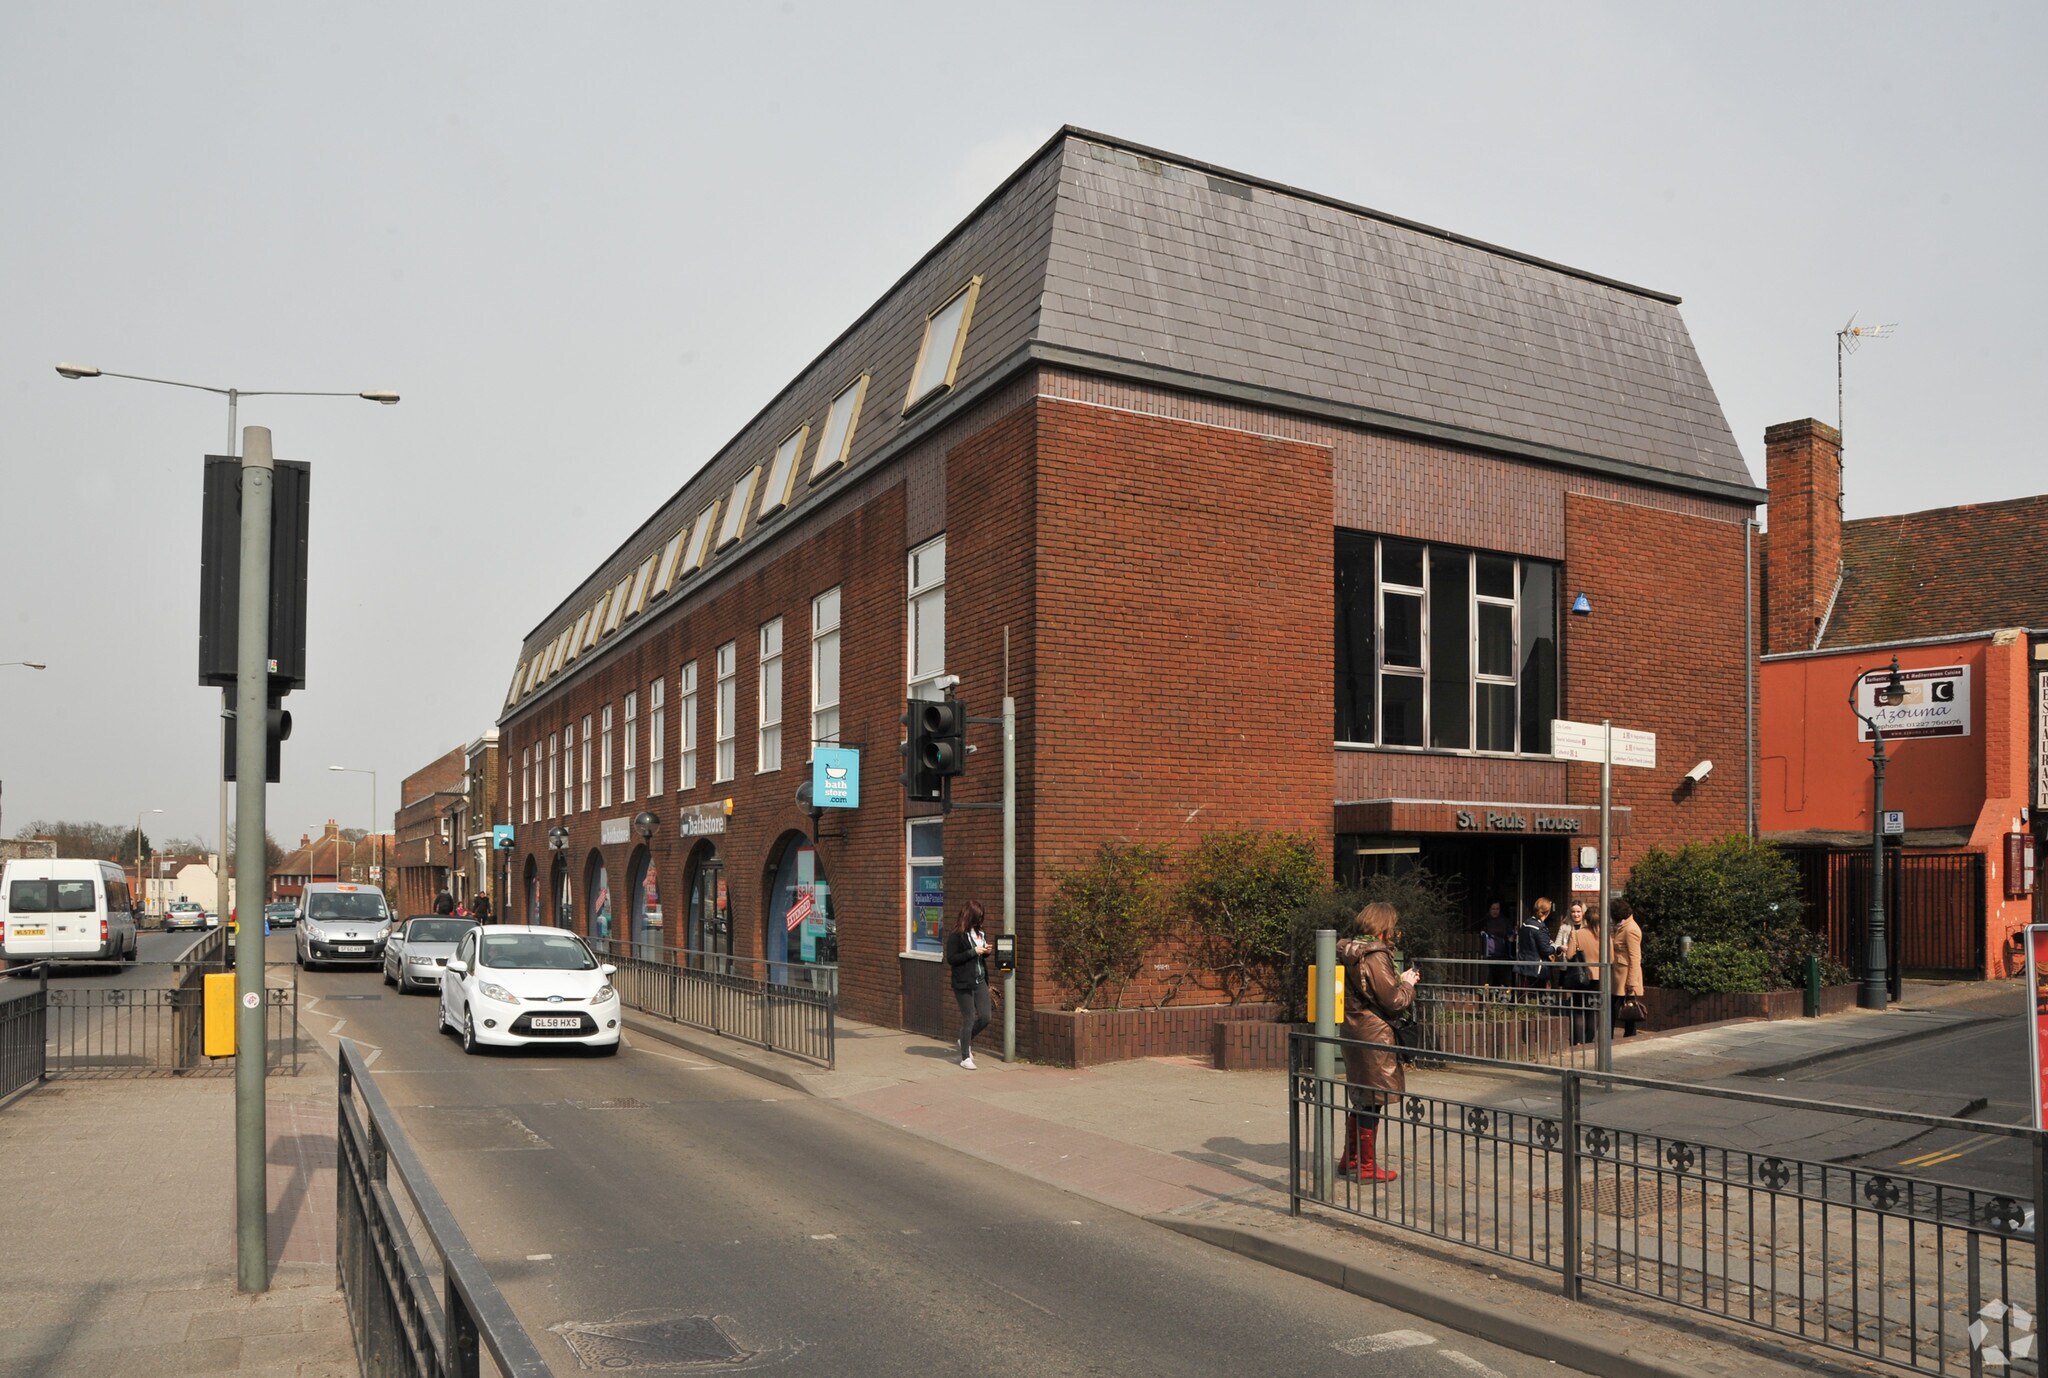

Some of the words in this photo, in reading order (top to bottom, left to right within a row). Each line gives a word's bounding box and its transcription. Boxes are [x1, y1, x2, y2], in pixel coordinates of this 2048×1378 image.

[1876, 706, 1952, 723] Azouma
[825, 780, 848, 789] bath
[825, 789, 848, 797] store
[689, 814, 724, 835] bathstore
[1458, 811, 1481, 829] St.
[1485, 812, 1527, 830] Pauls
[1534, 813, 1581, 831] House
[535, 1019, 558, 1027] GL58
[560, 1019, 577, 1027] HXS
